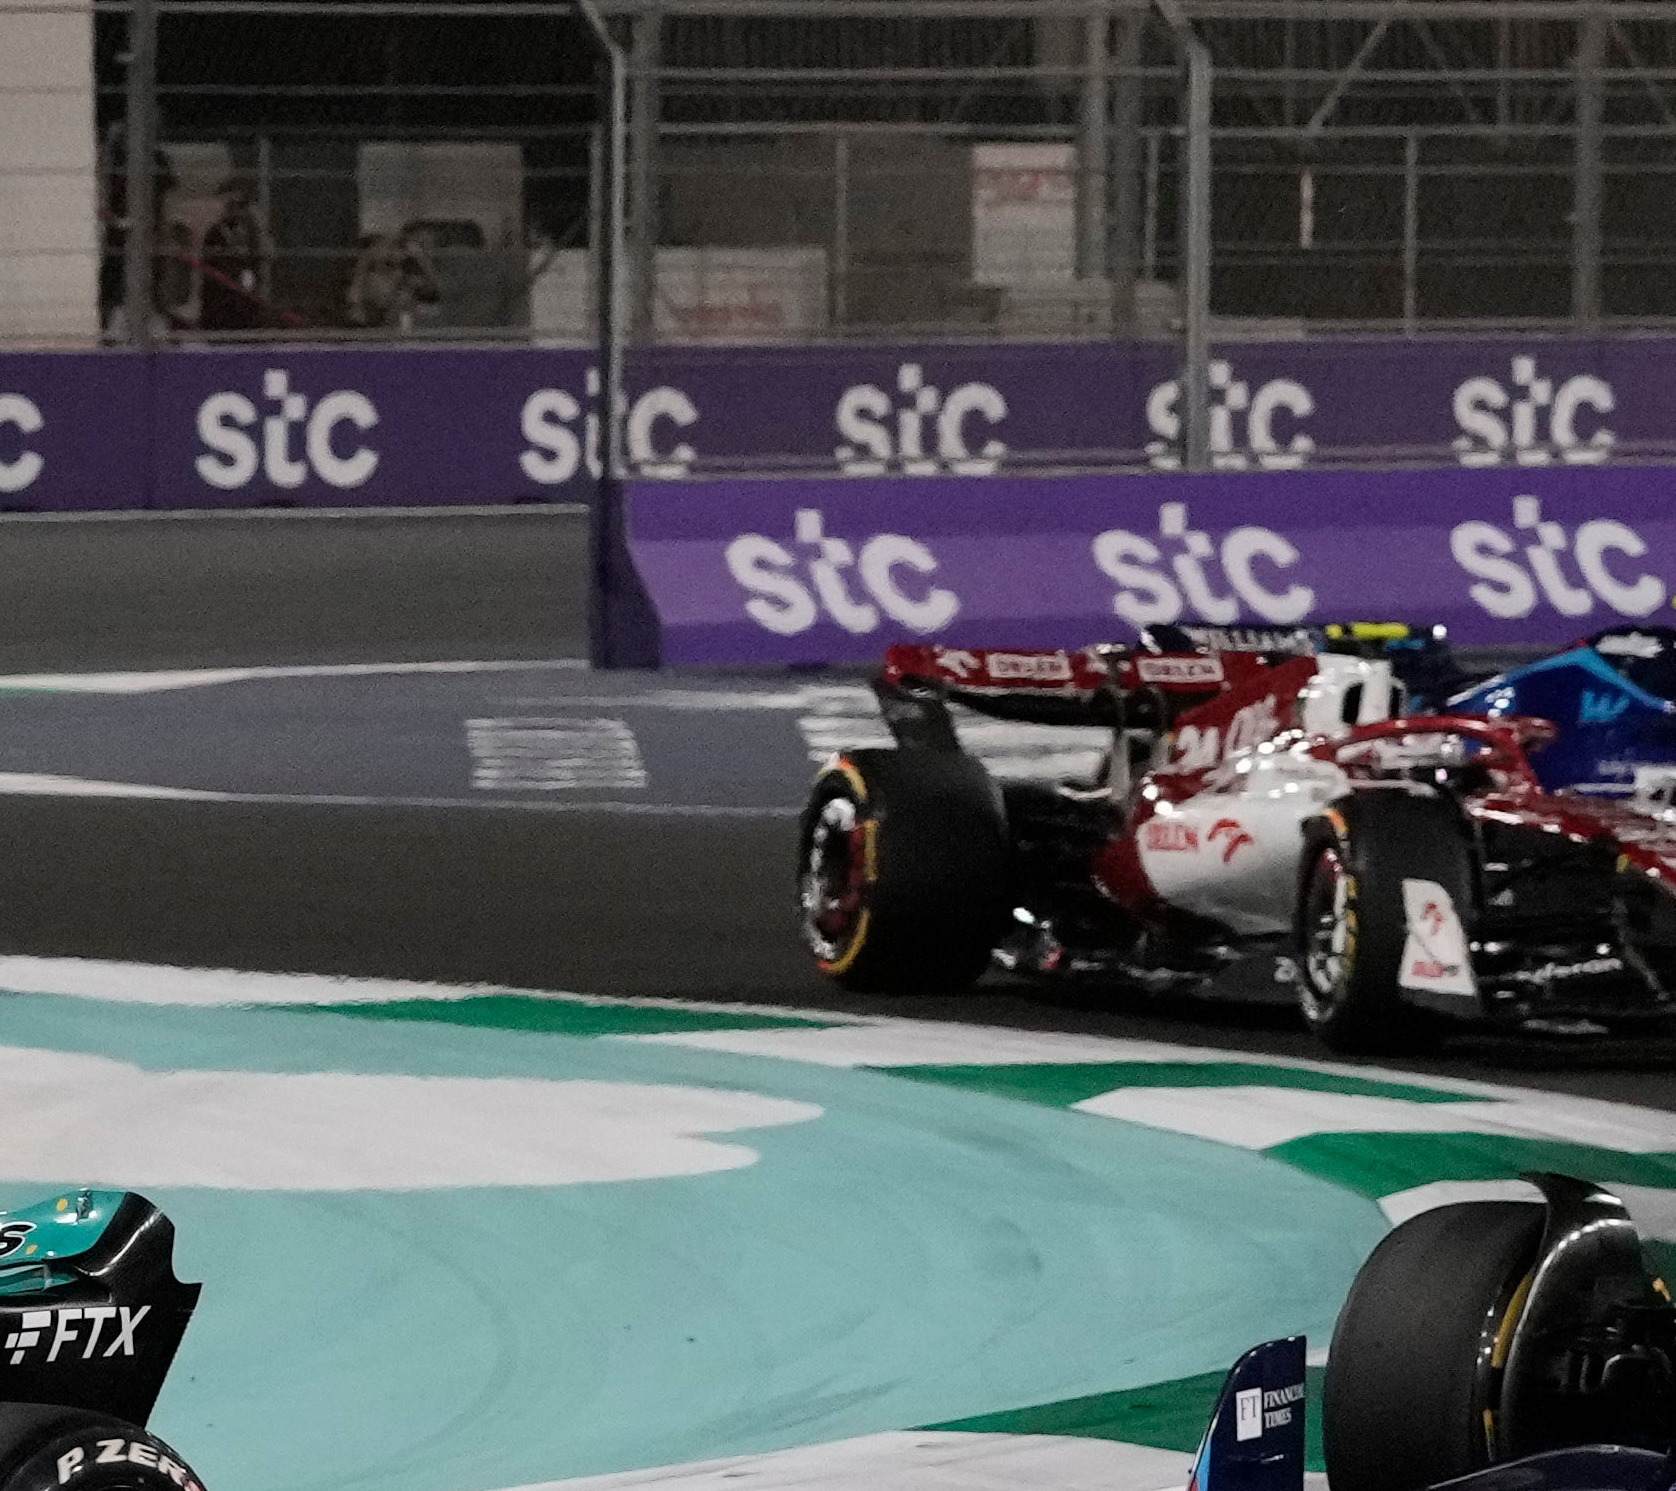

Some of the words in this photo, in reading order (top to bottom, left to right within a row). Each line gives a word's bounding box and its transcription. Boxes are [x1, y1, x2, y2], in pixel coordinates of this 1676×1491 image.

[197, 371, 377, 487] stc
[836, 364, 1008, 475] stc
[1452, 357, 1614, 468] stc
[725, 507, 960, 636] stc
[1093, 501, 1316, 627] stc
[1450, 496, 1666, 618] stc
[46, 1304, 151, 1364] FTX
